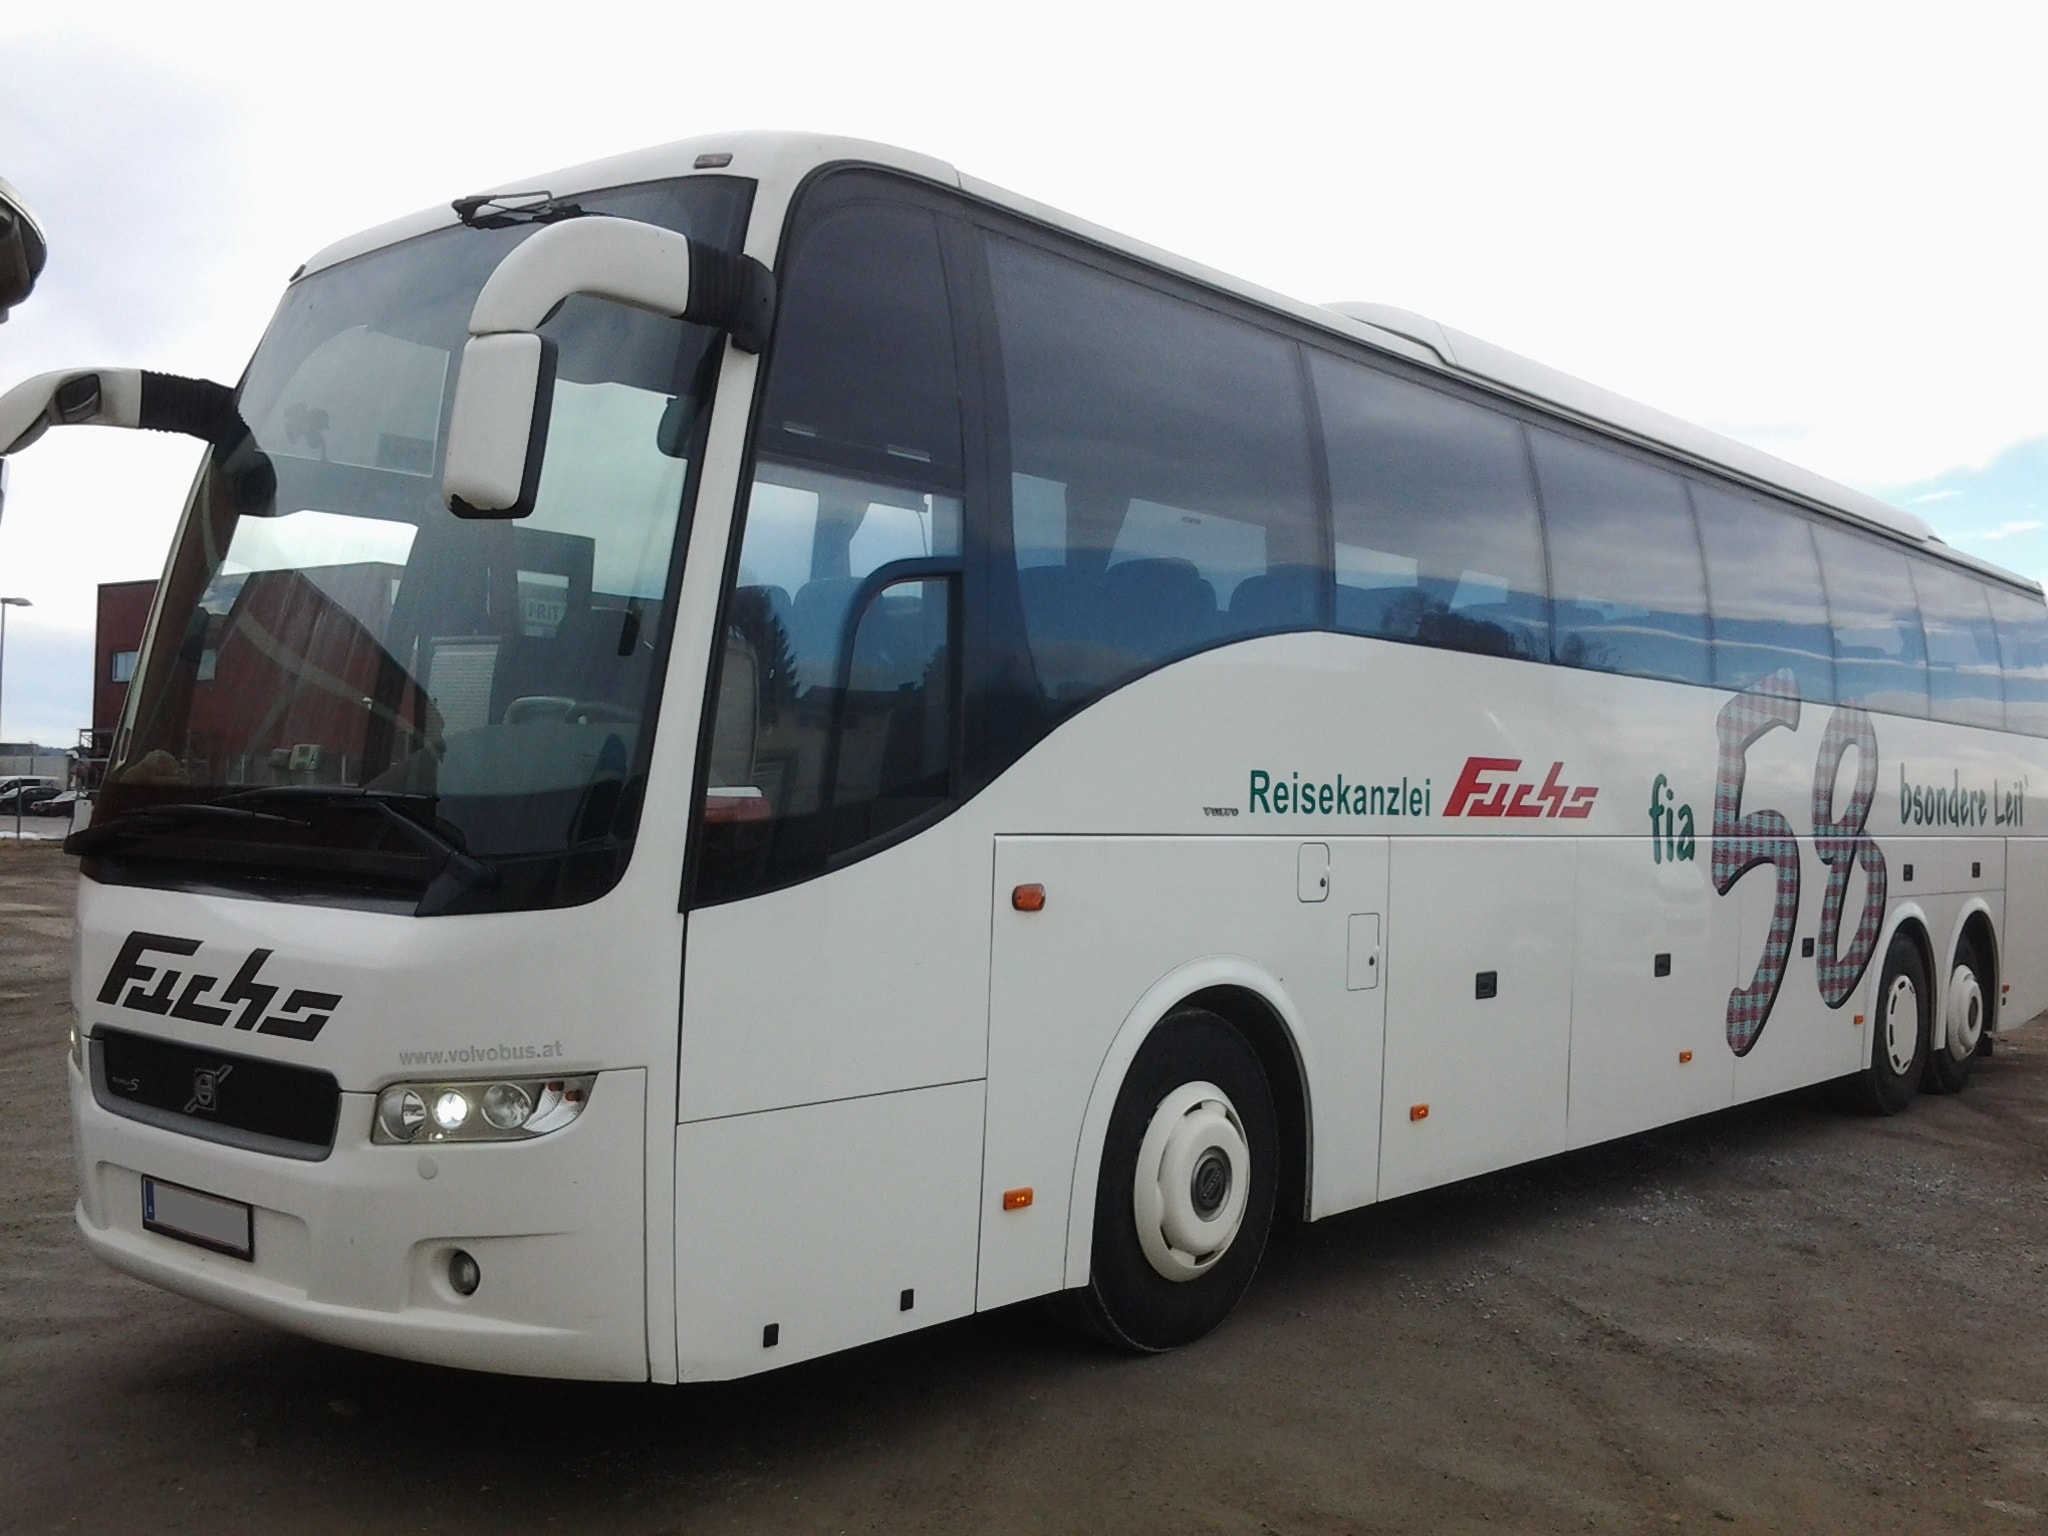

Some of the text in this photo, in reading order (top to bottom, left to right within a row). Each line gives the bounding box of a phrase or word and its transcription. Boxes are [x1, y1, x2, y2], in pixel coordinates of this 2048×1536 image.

[1248, 756, 1600, 818] Reisekanzlei Fuchs
[1648, 773, 1696, 865] fia
[1711, 666, 1888, 1058] 58
[1900, 762, 1988, 828] bsondere
[96, 930, 343, 1042] Fuchs
[399, 1040, 563, 1066] www.volvobus.at
